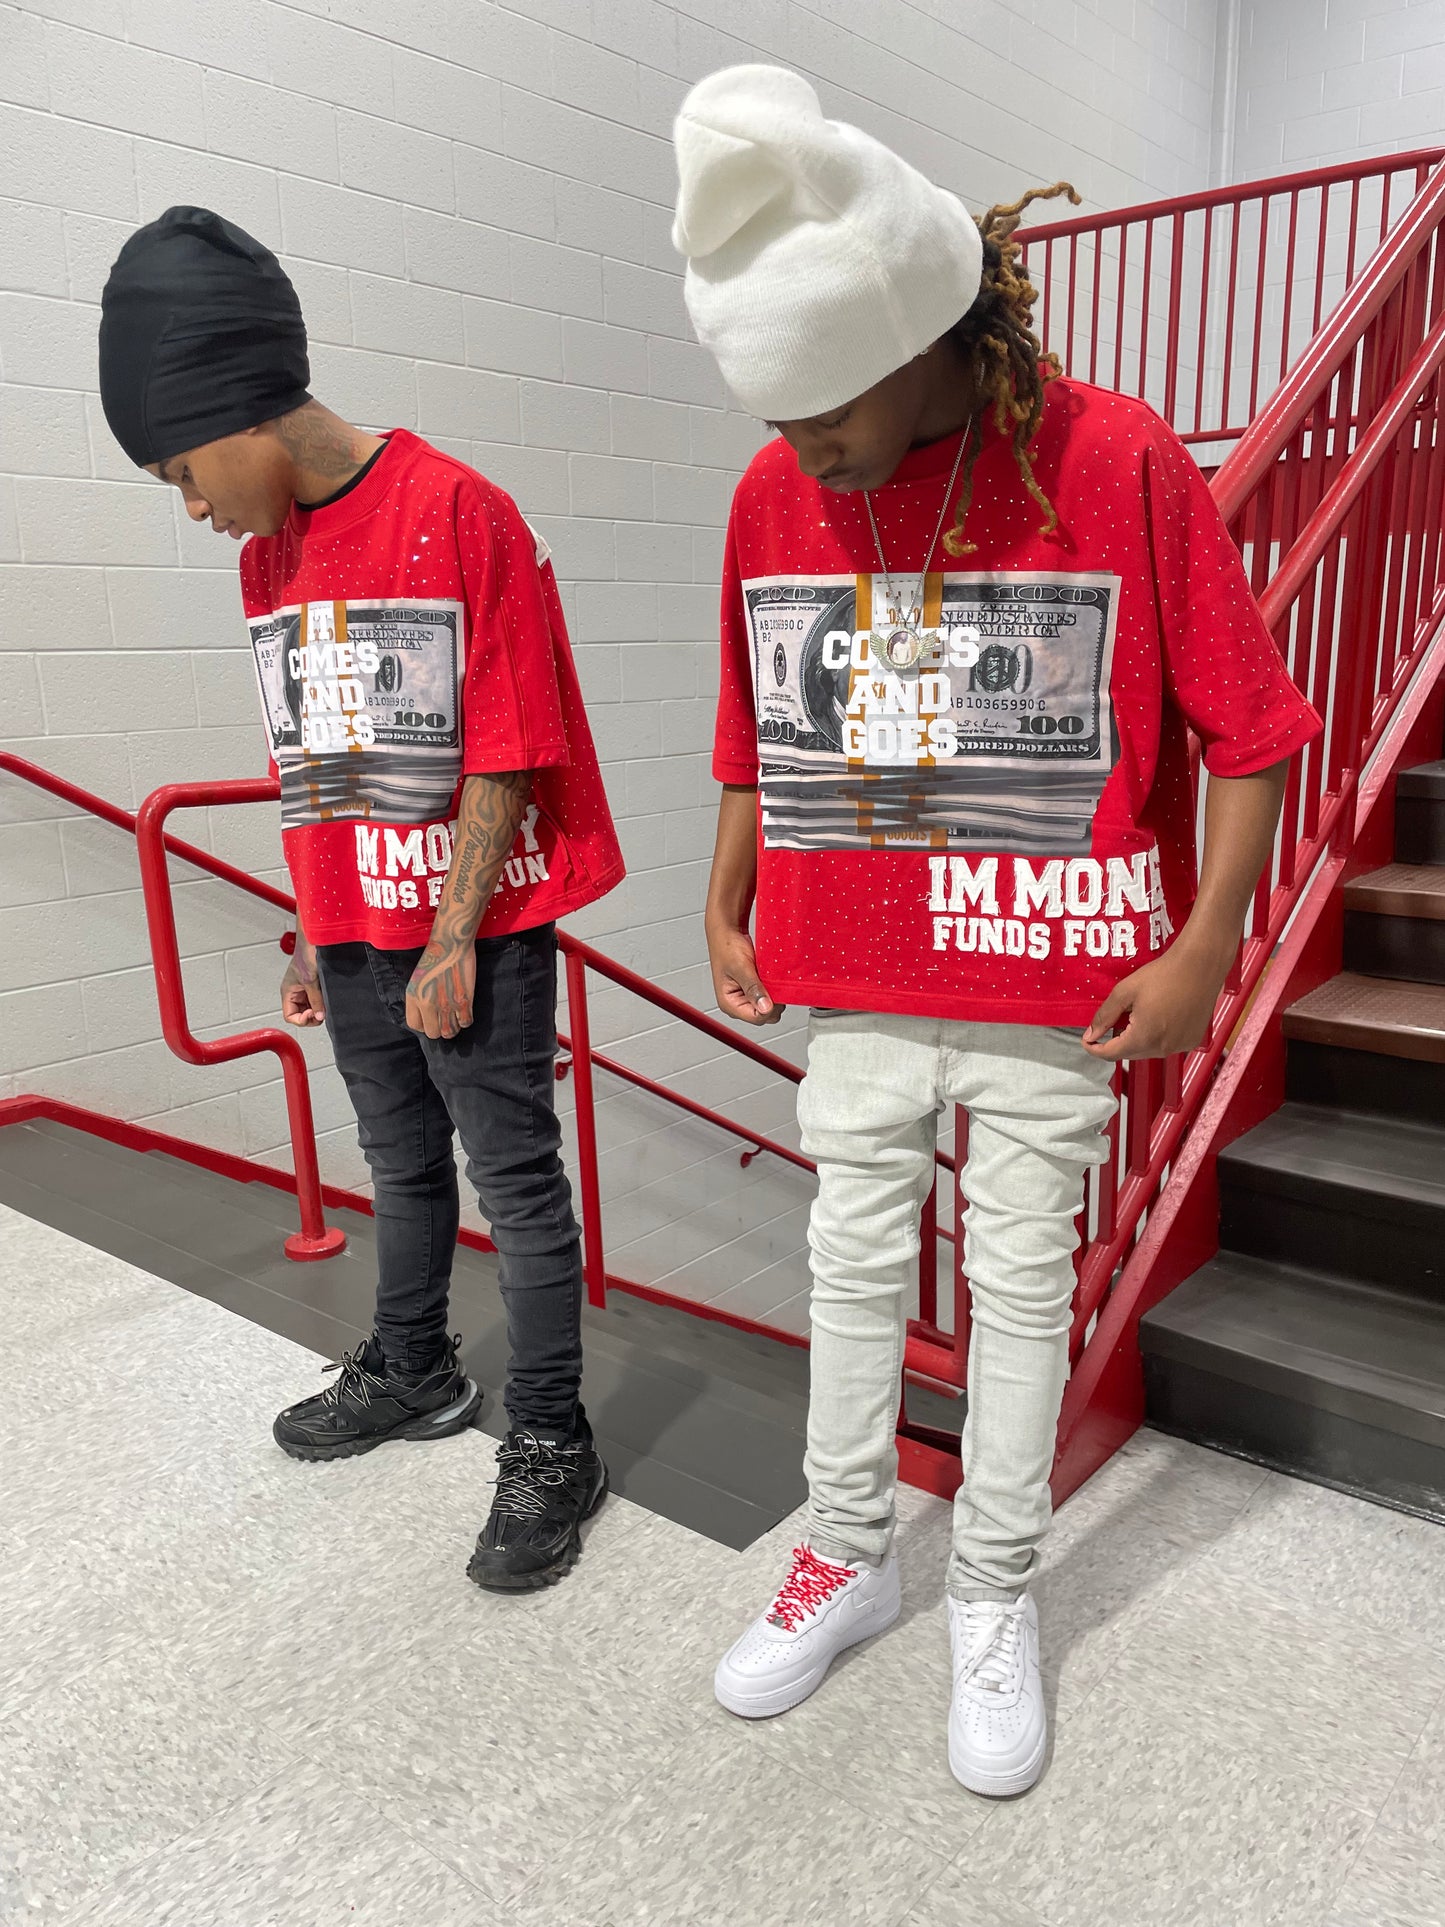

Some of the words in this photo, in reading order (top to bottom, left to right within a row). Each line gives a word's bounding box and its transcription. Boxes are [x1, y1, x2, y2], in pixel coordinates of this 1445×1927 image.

[993, 586, 1098, 603] 100
[381, 609, 448, 624] 100
[941, 611, 1000, 624] NITED
[1002, 612, 1077, 626] STATES
[762, 632, 772, 643] B2
[822, 629, 981, 670] COES
[288, 641, 380, 681] COMES
[302, 678, 366, 714] AND
[846, 673, 951, 714] AND
[301, 714, 376, 749] GOES
[393, 710, 447, 729] 100
[1016, 715, 1085, 735] 100
[394, 733, 452, 743] DOLLARS
[842, 718, 958, 760] GOES
[957, 741, 1014, 751] NDRED
[1016, 743, 1090, 753] DOLLARS
[928, 856, 1001, 916] IM
[932, 916, 1051, 961] FUNDS
[1063, 919, 1138, 961] FOR
